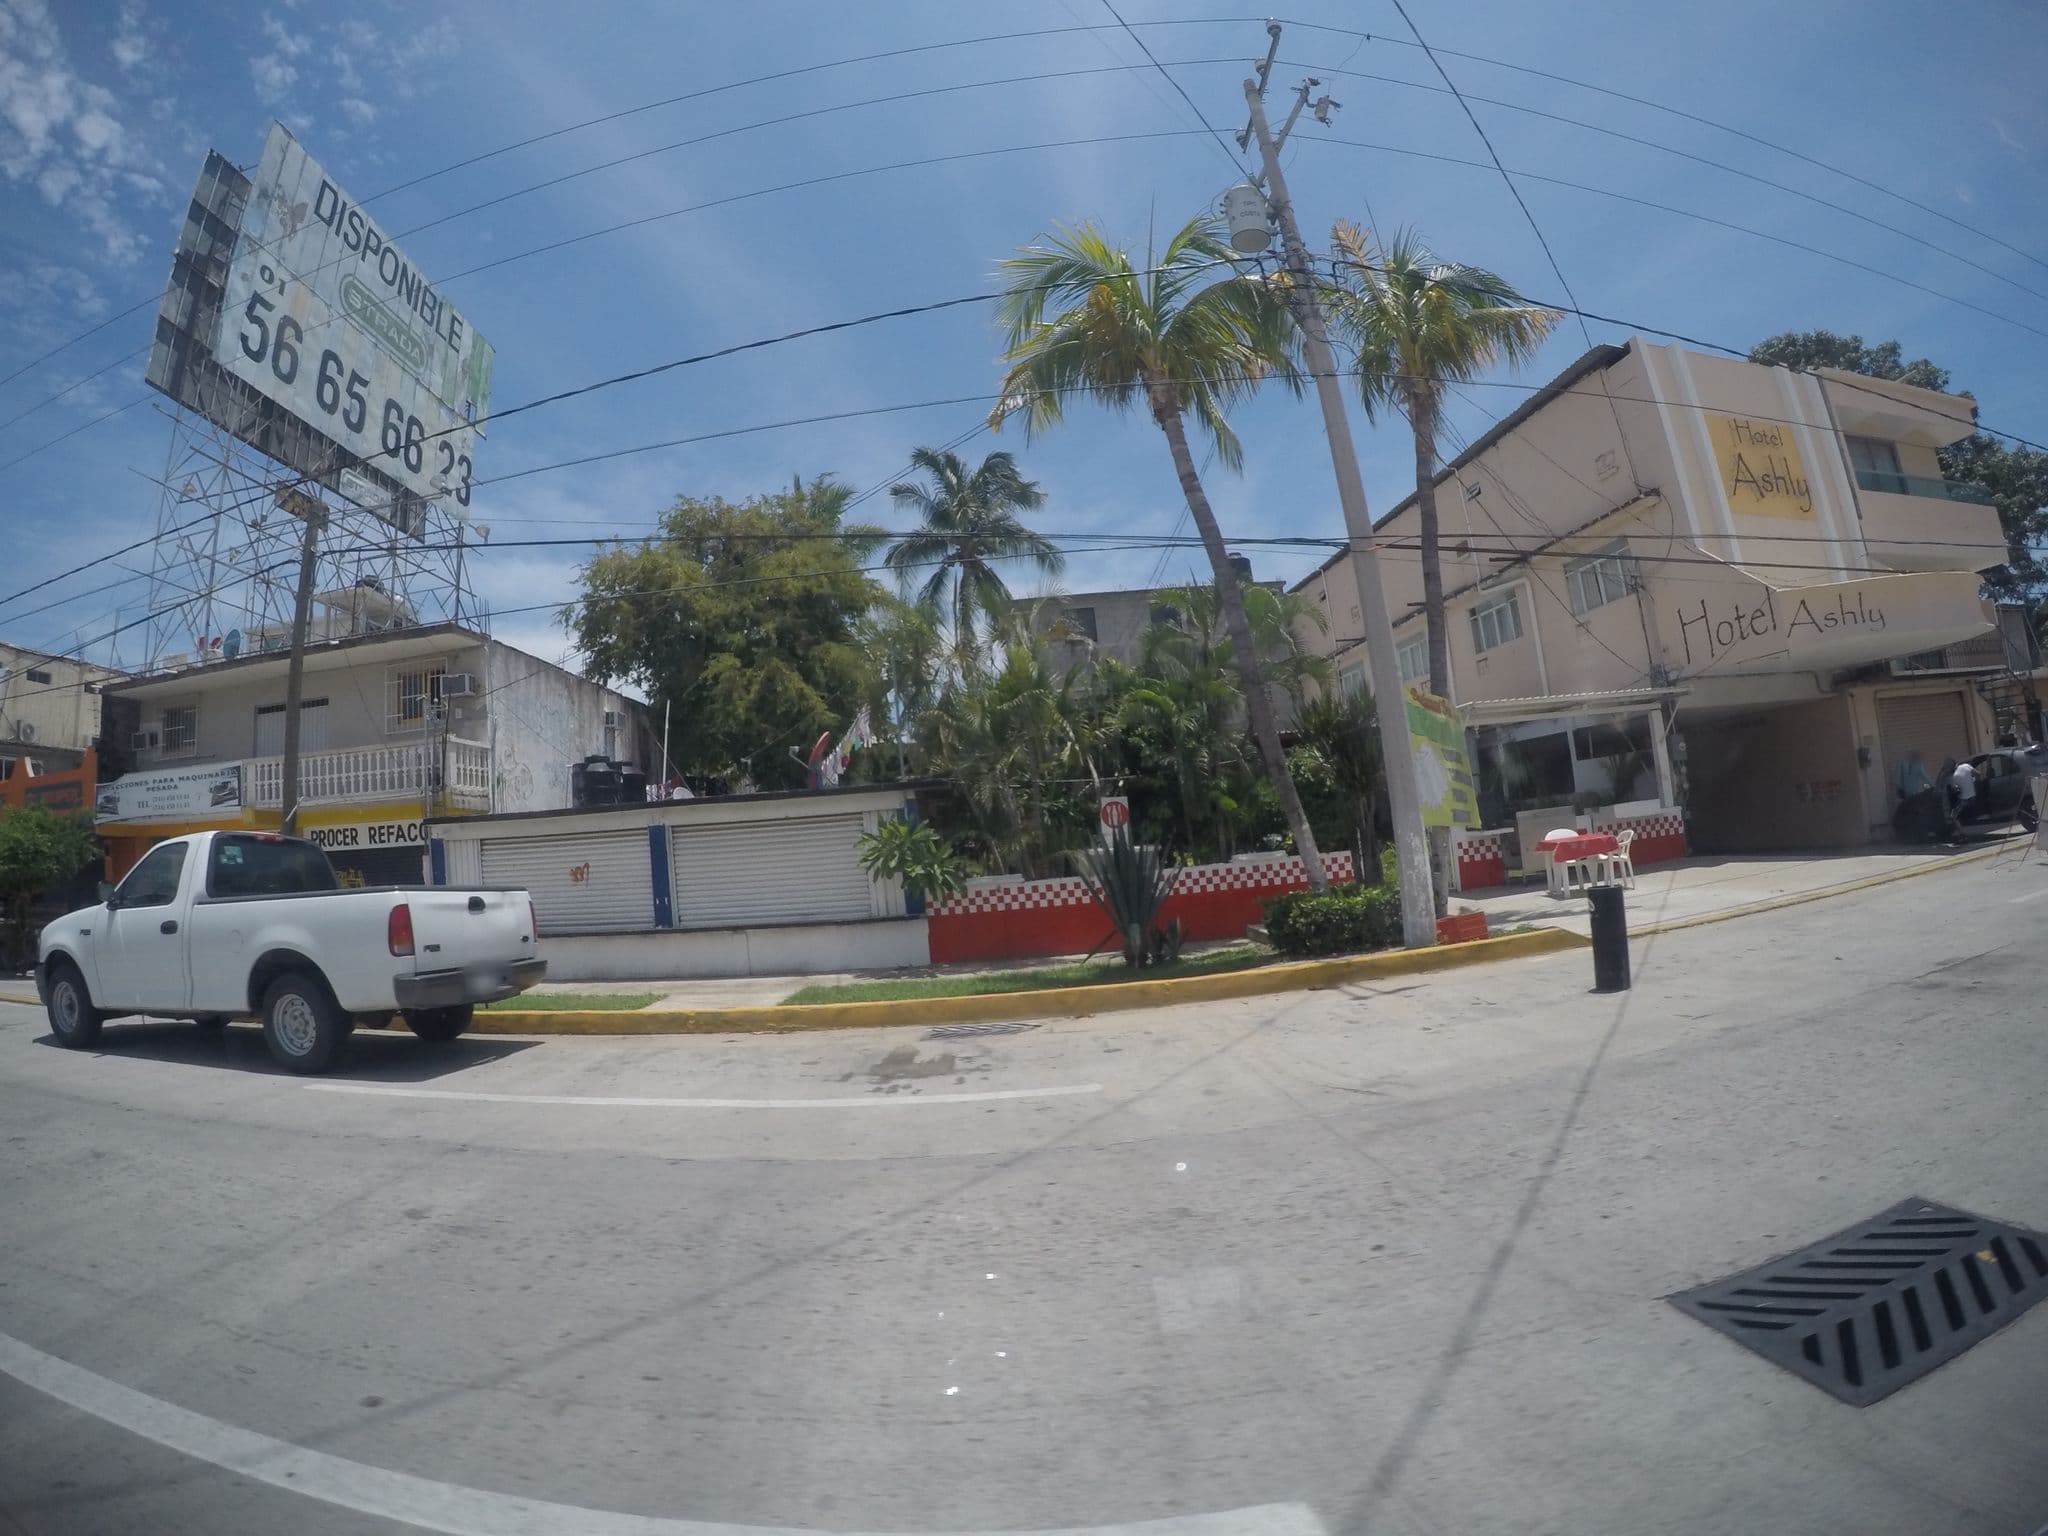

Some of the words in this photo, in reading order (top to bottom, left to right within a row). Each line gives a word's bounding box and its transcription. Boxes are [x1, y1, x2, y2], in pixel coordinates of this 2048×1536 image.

[314, 179, 464, 354] DISPONIBLE
[240, 289, 304, 386] 56
[316, 348, 371, 435] 65
[381, 397, 425, 475] 66
[438, 439, 473, 507] 23
[1732, 417, 1784, 447] Hotel
[1732, 452, 1813, 513] Ashly
[1676, 586, 1777, 665] Hotel
[1786, 591, 1886, 639] Ashly
[146, 784, 178, 793] PESADA
[152, 776, 175, 785] PARA
[310, 827, 359, 848] PROCER
